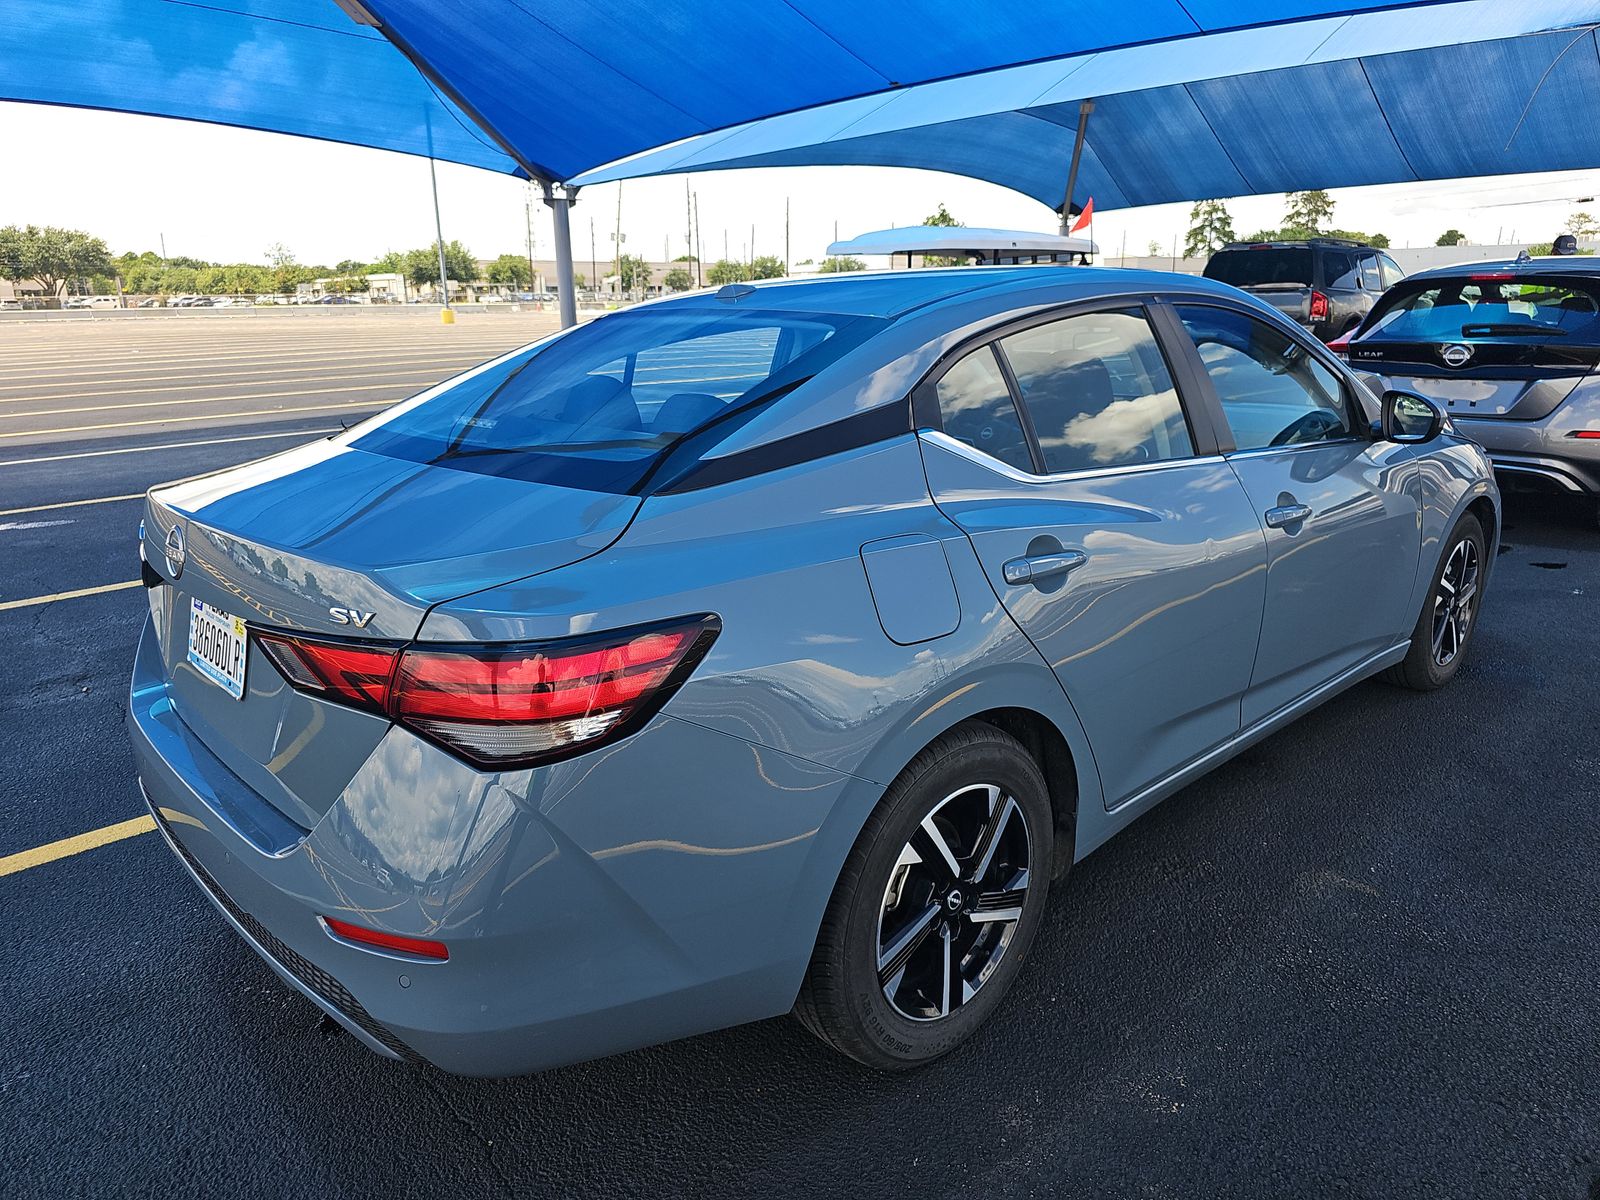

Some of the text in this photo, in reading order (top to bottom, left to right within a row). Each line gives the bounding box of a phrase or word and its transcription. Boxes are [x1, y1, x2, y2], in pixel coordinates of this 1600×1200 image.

[329, 607, 377, 628] SV
[869, 1016, 886, 1037] R16
[882, 1034, 913, 1054] 205/60
